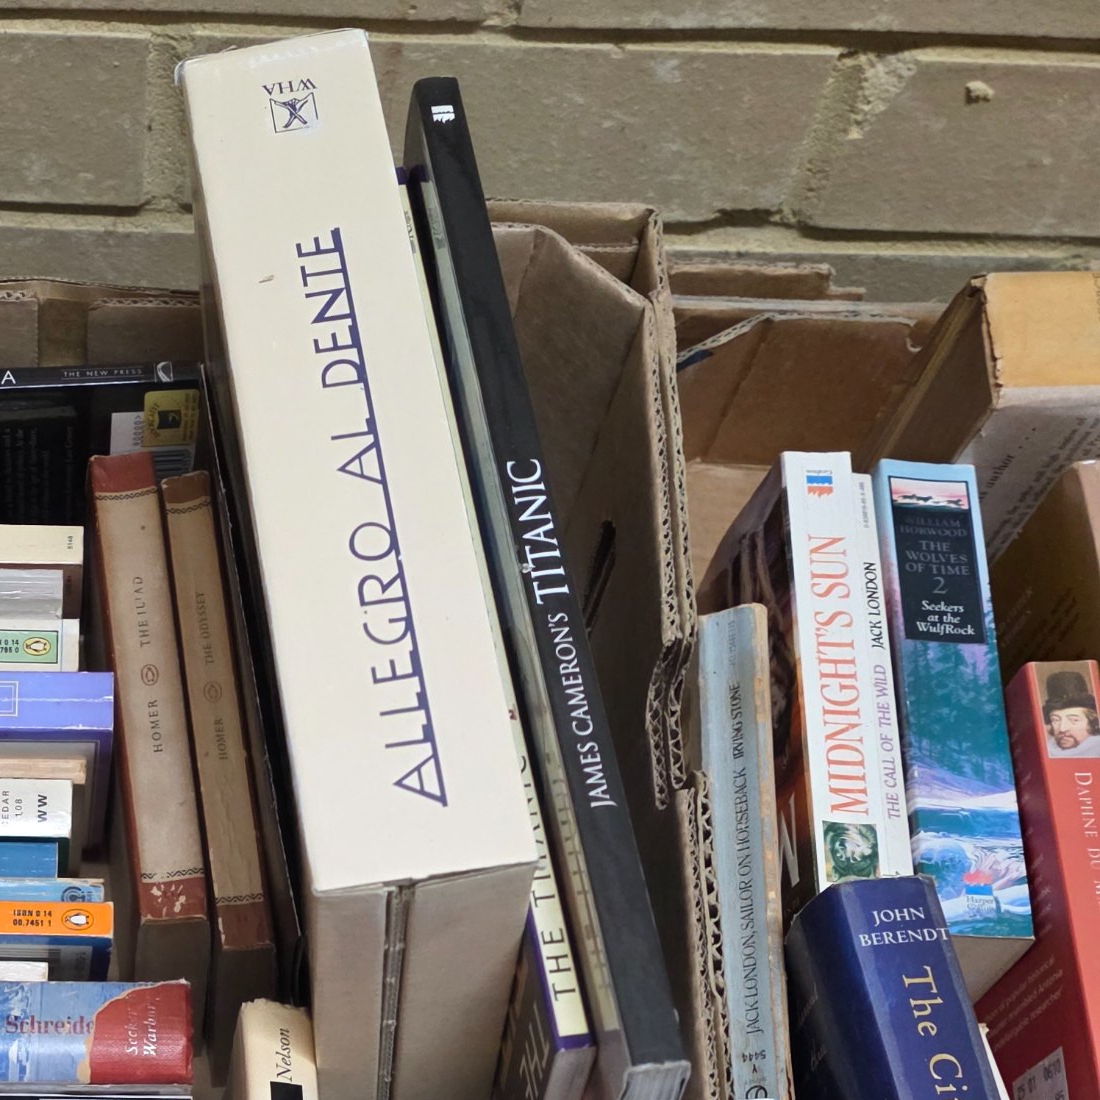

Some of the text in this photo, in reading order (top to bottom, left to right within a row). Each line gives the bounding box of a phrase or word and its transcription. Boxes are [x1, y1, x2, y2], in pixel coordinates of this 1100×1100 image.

[295, 227, 448, 807] ALLEGRO AL DENTE
[506, 458, 570, 605] TITANIC
[808, 534, 852, 599] SUN
[916, 622, 976, 636] WulfRock
[921, 600, 964, 613] Seekers
[548, 612, 593, 736] CAMERON'S
[146, 699, 163, 753] HOMER
[813, 609, 869, 816] MIDNIGHT'S
[574, 742, 617, 809] JAMES
[859, 927, 950, 947] BERENDT
[871, 907, 925, 927] JOHN
[902, 966, 944, 1037] The
[276, 1027, 293, 1082] Nelson
